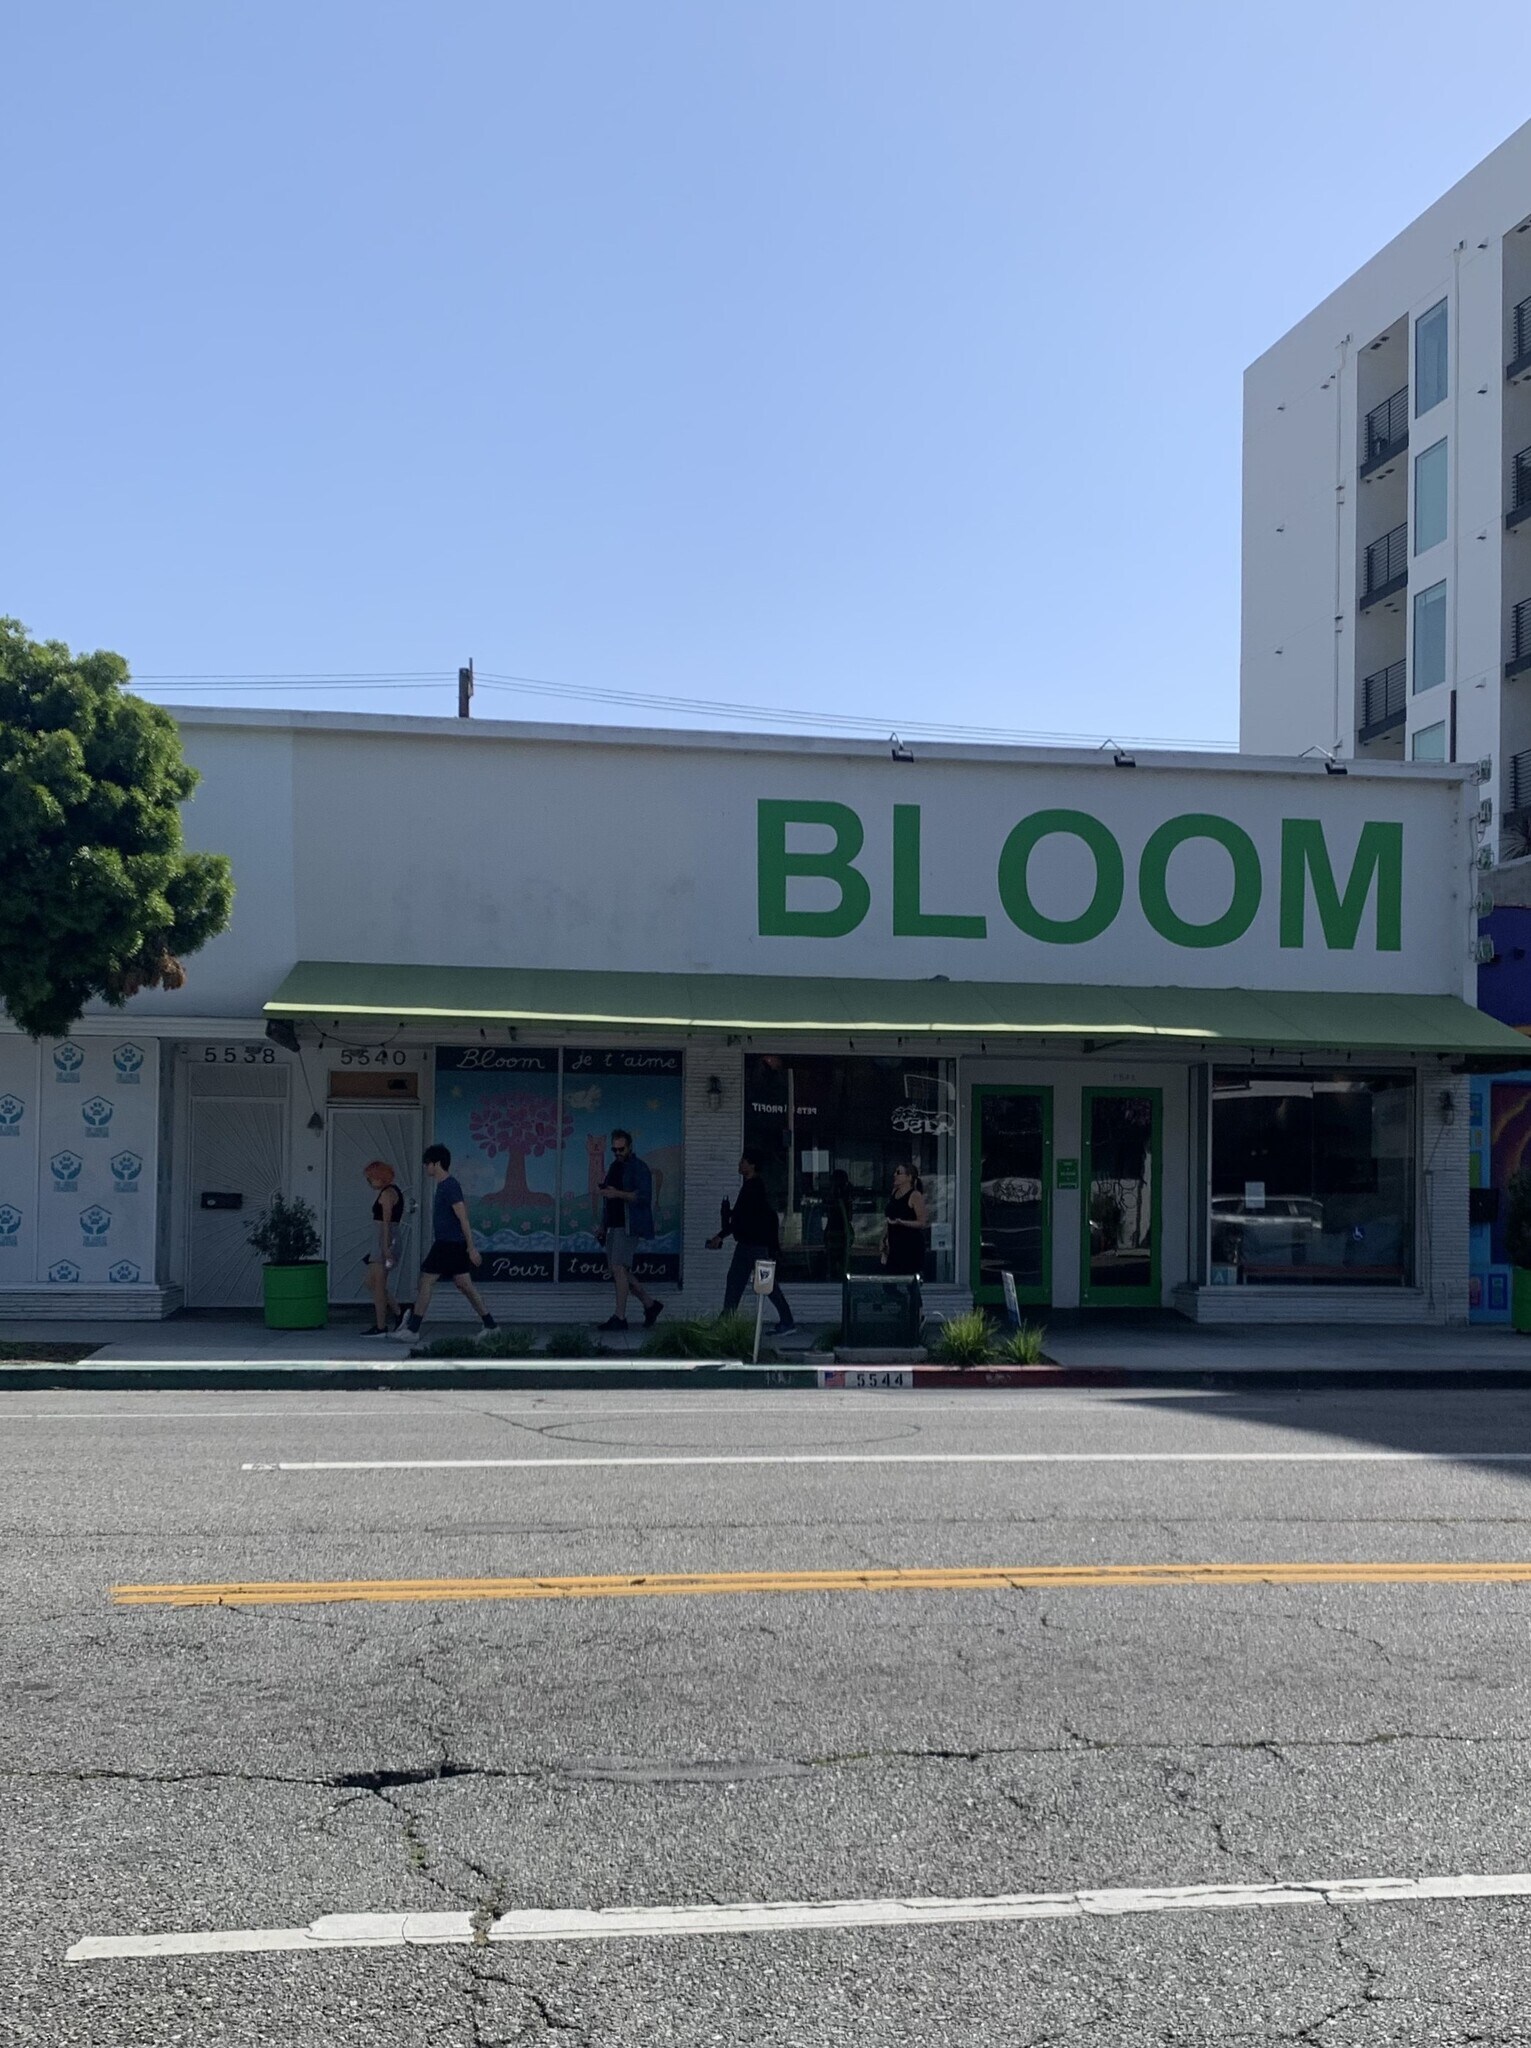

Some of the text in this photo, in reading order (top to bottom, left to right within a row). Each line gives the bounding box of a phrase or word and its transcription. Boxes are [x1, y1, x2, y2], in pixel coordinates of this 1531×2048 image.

[757, 798, 1403, 951] BLOOM
[204, 1046, 275, 1064] 5538
[340, 1049, 406, 1066] 5540
[456, 1048, 545, 1069] Bloom
[572, 1051, 592, 1070] je
[492, 1257, 667, 1280] Pour toujurs
[856, 1372, 904, 1388] 5544
